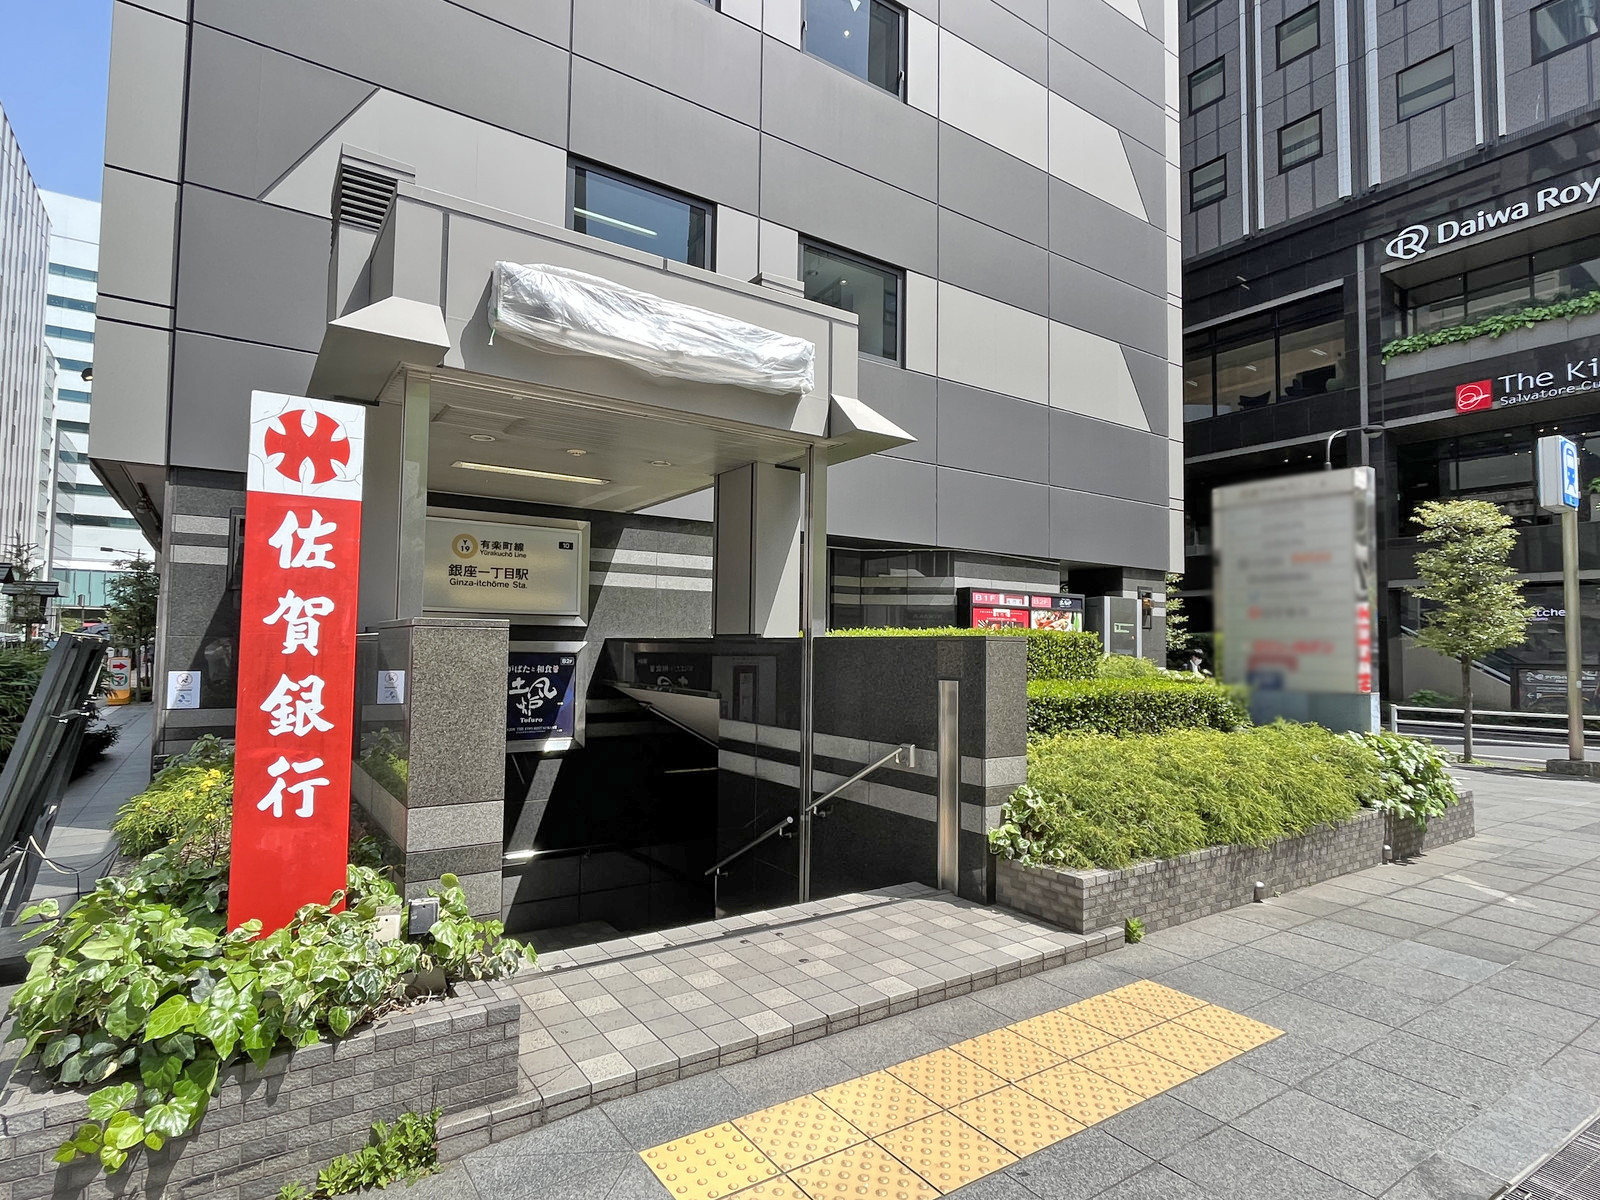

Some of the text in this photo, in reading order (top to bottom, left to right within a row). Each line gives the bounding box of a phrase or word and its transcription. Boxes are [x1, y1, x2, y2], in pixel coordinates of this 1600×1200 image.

[1438, 202, 1529, 244] Daiwa
[1537, 177, 1600, 212] Roy
[1498, 357, 1598, 393] The Ki
[1500, 385, 1576, 406] Salvatore
[480, 539, 525, 552] 有楽町線
[514, 551, 527, 559] Line
[448, 563, 529, 580] 銀座一丁目駅
[512, 580, 528, 589] Sta.
[975, 594, 996, 602] B1F
[257, 509, 337, 818] 佐賀銀行
